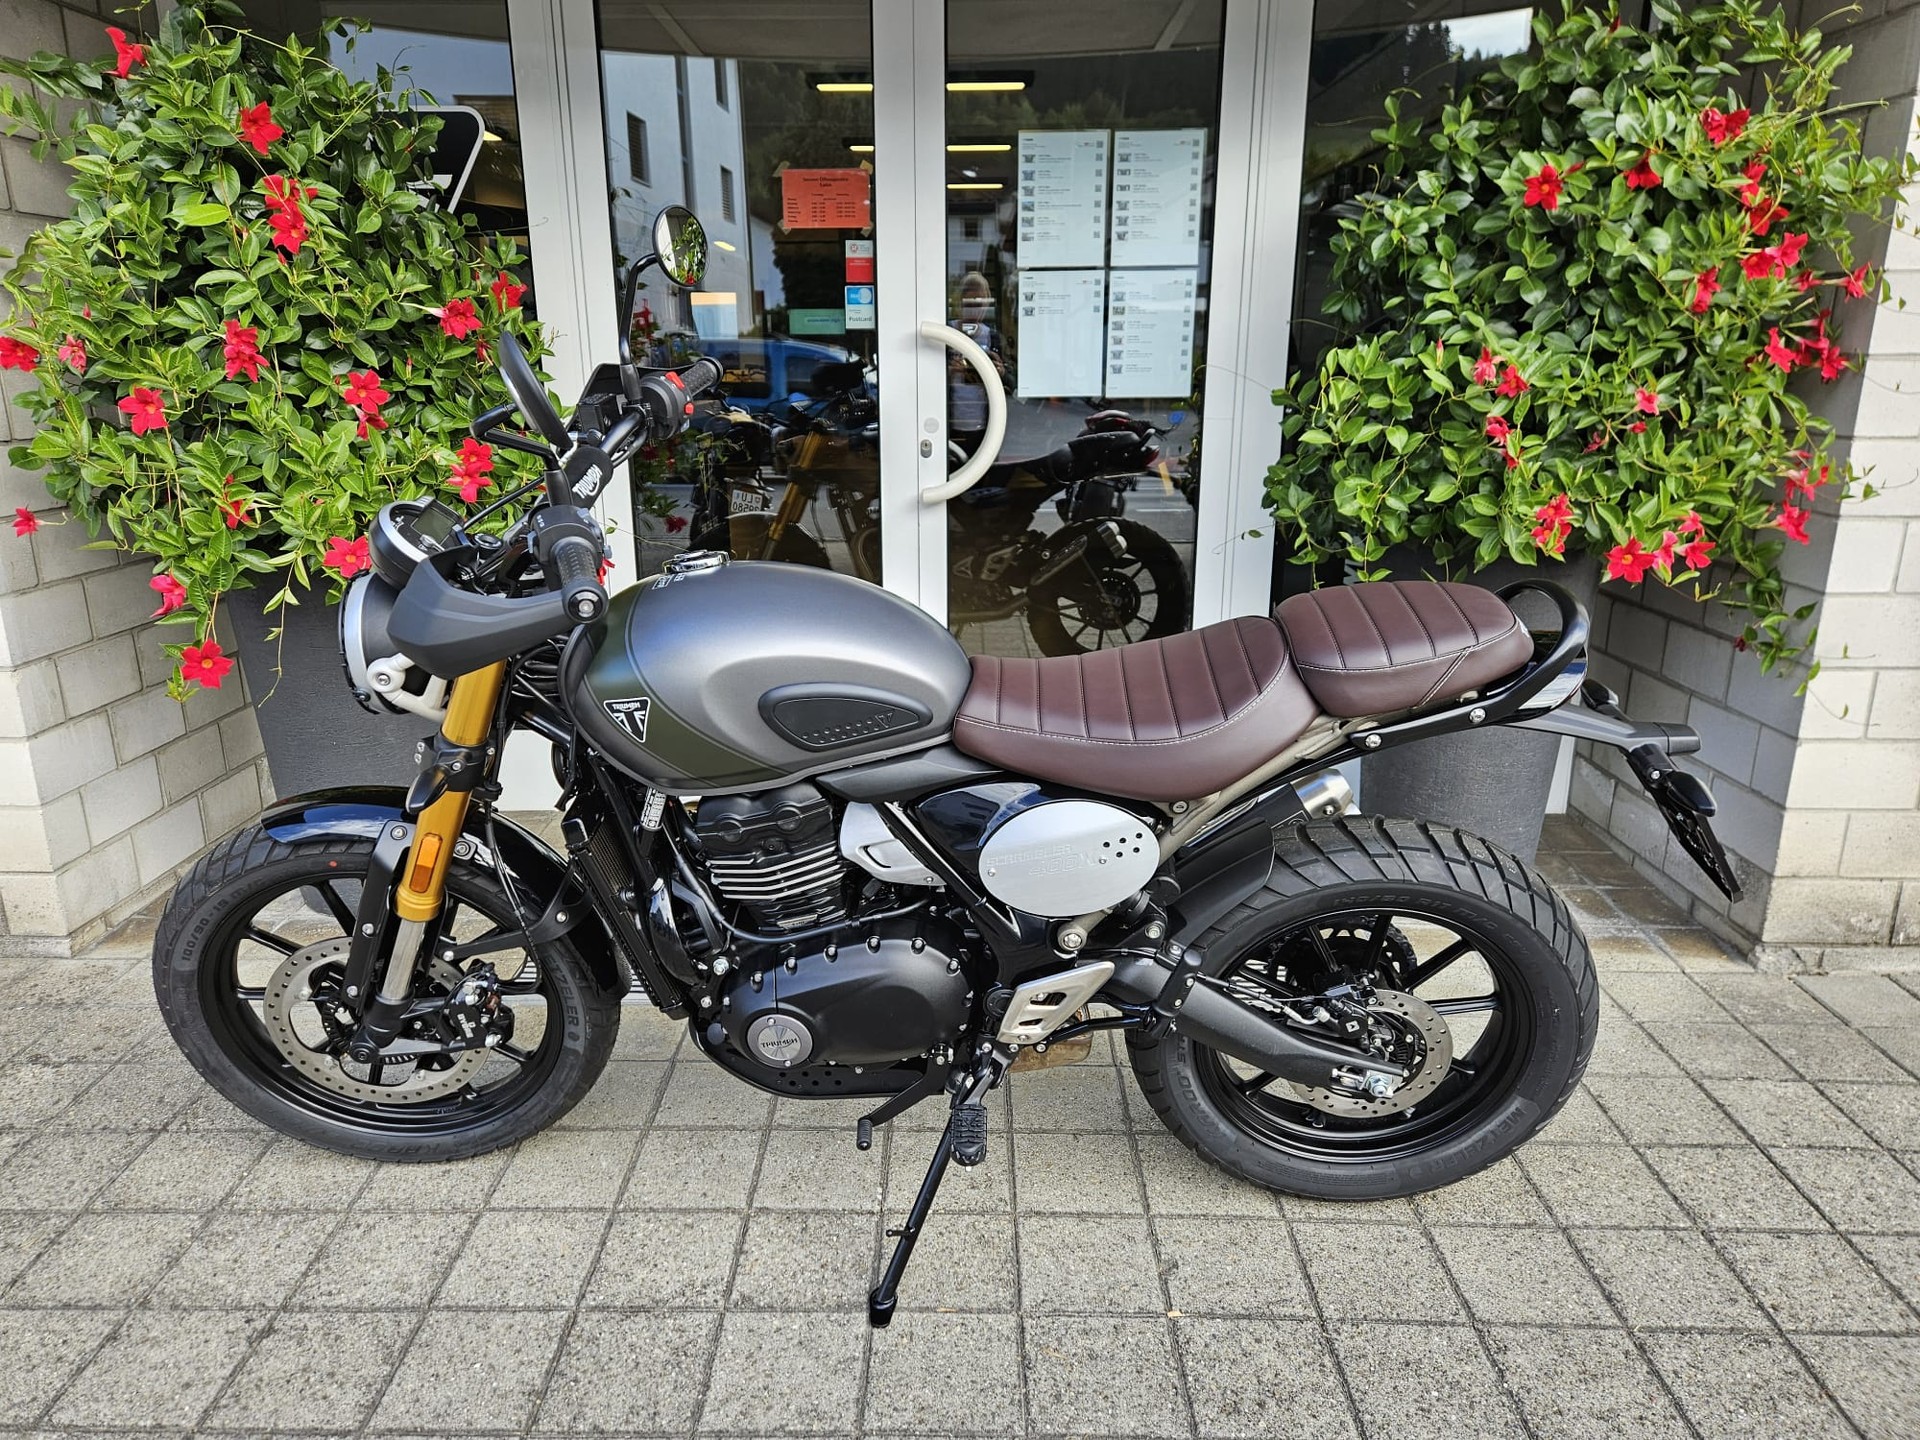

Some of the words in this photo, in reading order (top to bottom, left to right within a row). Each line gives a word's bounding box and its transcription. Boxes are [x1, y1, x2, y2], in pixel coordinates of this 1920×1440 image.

[572, 464, 603, 498] TRIUMPH
[612, 702, 641, 712] TRIUMPH
[541, 951, 581, 1027] ETZELER
[760, 1037, 799, 1049] TRIUMPH
